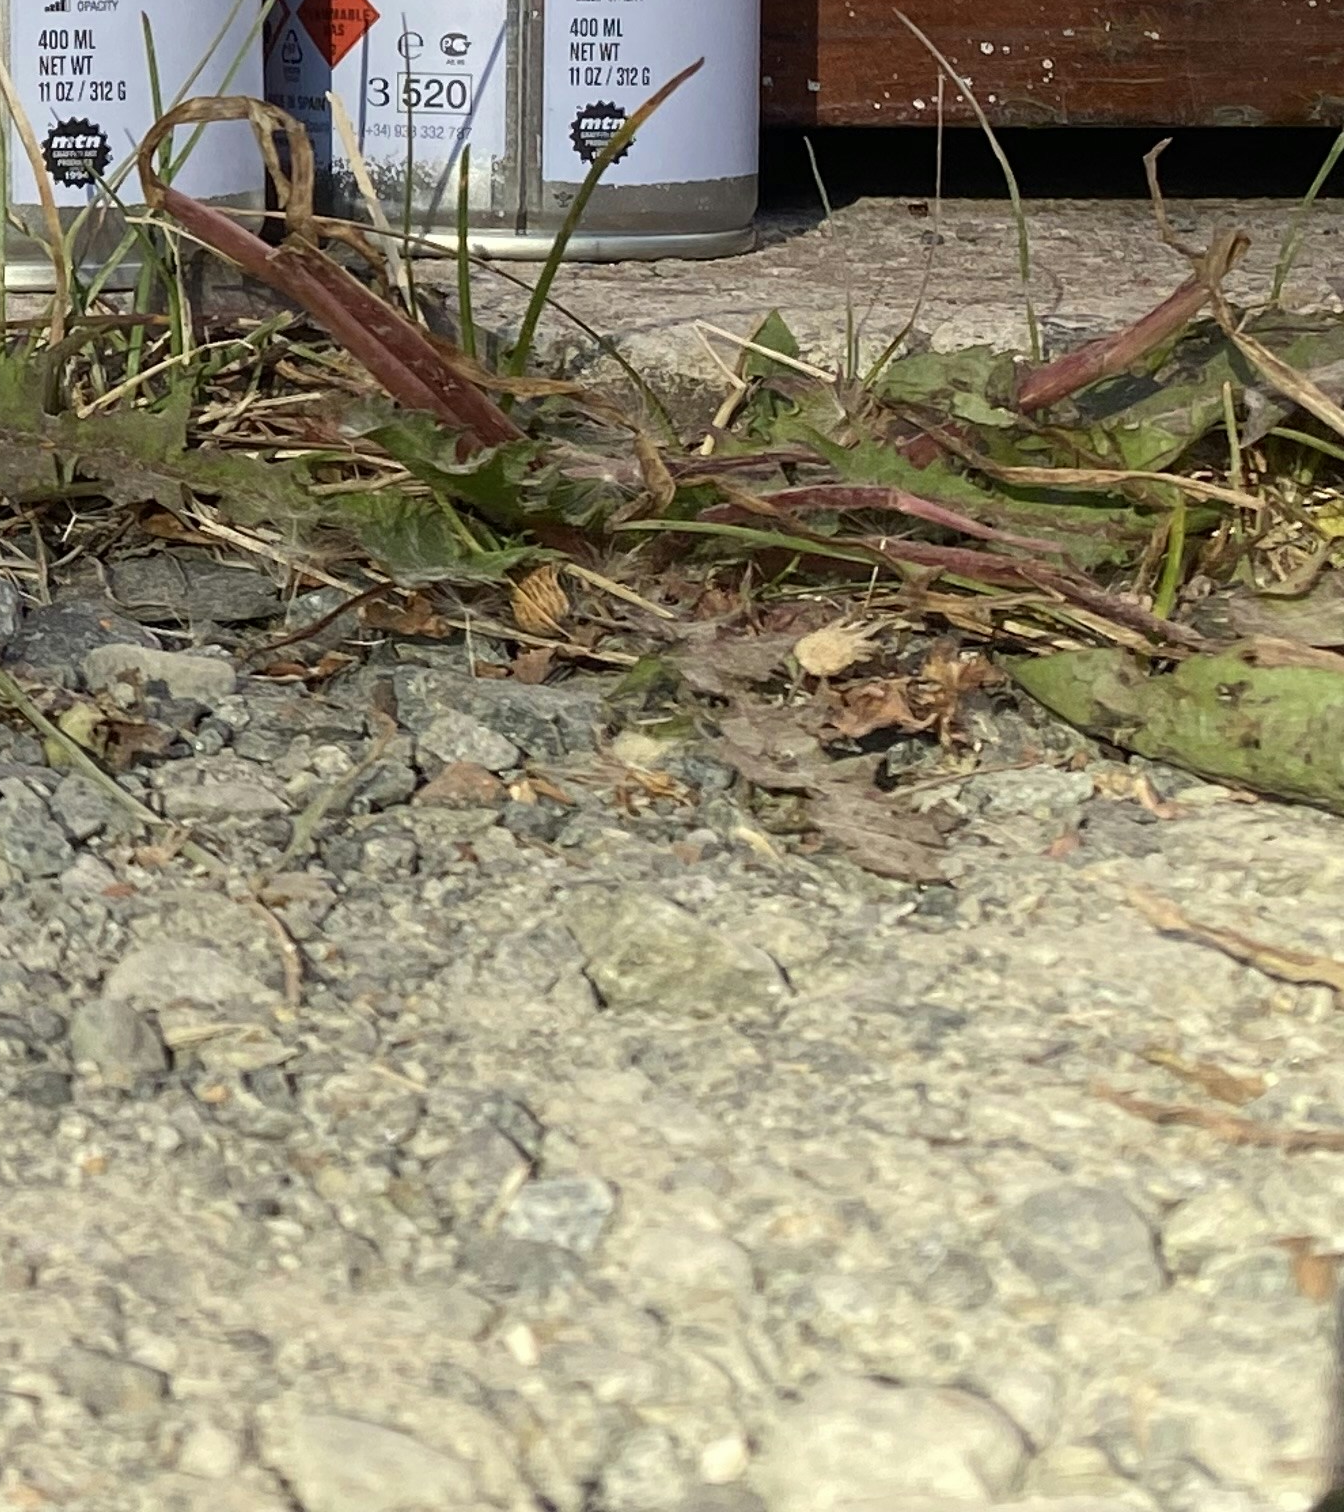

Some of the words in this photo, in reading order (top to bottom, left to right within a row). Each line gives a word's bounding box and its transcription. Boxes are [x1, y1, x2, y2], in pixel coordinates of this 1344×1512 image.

[77, 0, 120, 12] OPACITY
[569, 17, 599, 38] 400
[603, 17, 624, 38] ML
[37, 29, 69, 50] 400
[73, 29, 97, 50] ML
[569, 42, 595, 62] NET
[599, 42, 621, 62] WT
[39, 55, 66, 76] NET
[70, 55, 94, 76] WT
[568, 67, 580, 86] 11
[584, 67, 602, 86] OZ
[616, 66, 639, 86] 312
[641, 66, 651, 86] G
[37, 81, 51, 102] 11
[55, 81, 75, 102] OZ
[89, 80, 114, 101] 312
[117, 80, 127, 101] G
[366, 77, 391, 107] 3
[401, 78, 468, 109] 520
[419, 125, 444, 140] 332
[579, 116, 627, 131] mtn
[51, 134, 102, 149] mtn
